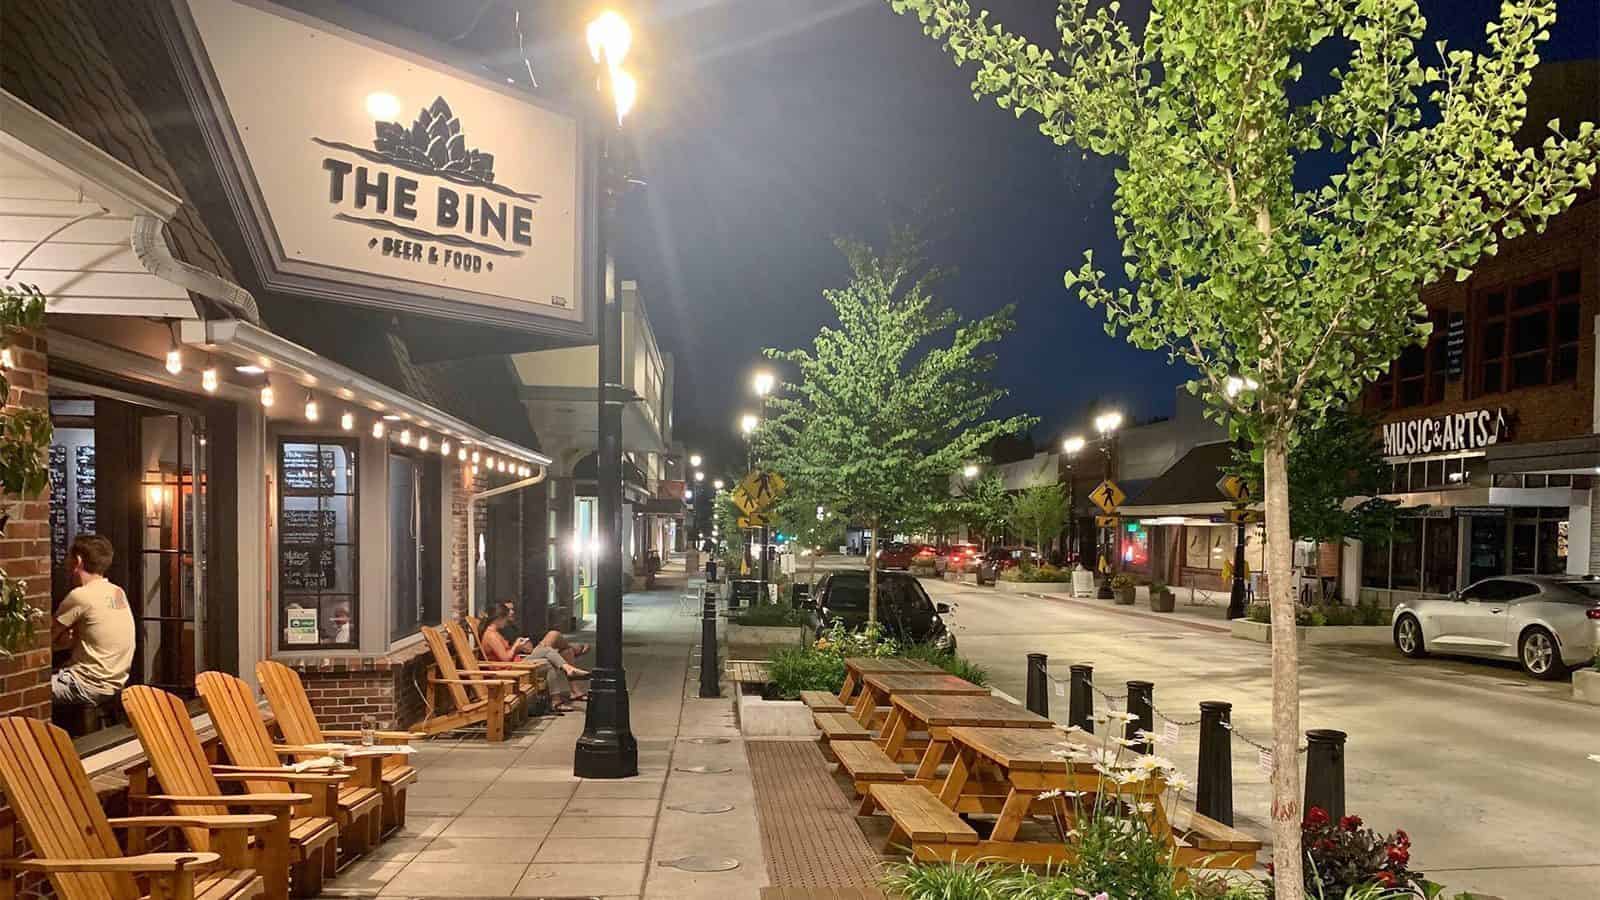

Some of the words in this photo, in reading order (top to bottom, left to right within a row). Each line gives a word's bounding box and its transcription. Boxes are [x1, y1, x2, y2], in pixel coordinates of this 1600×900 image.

[323, 158, 418, 221] THE
[436, 186, 533, 247] BINE
[382, 236, 423, 262] BEER
[428, 246, 439, 265] &
[444, 249, 482, 273] FOOD
